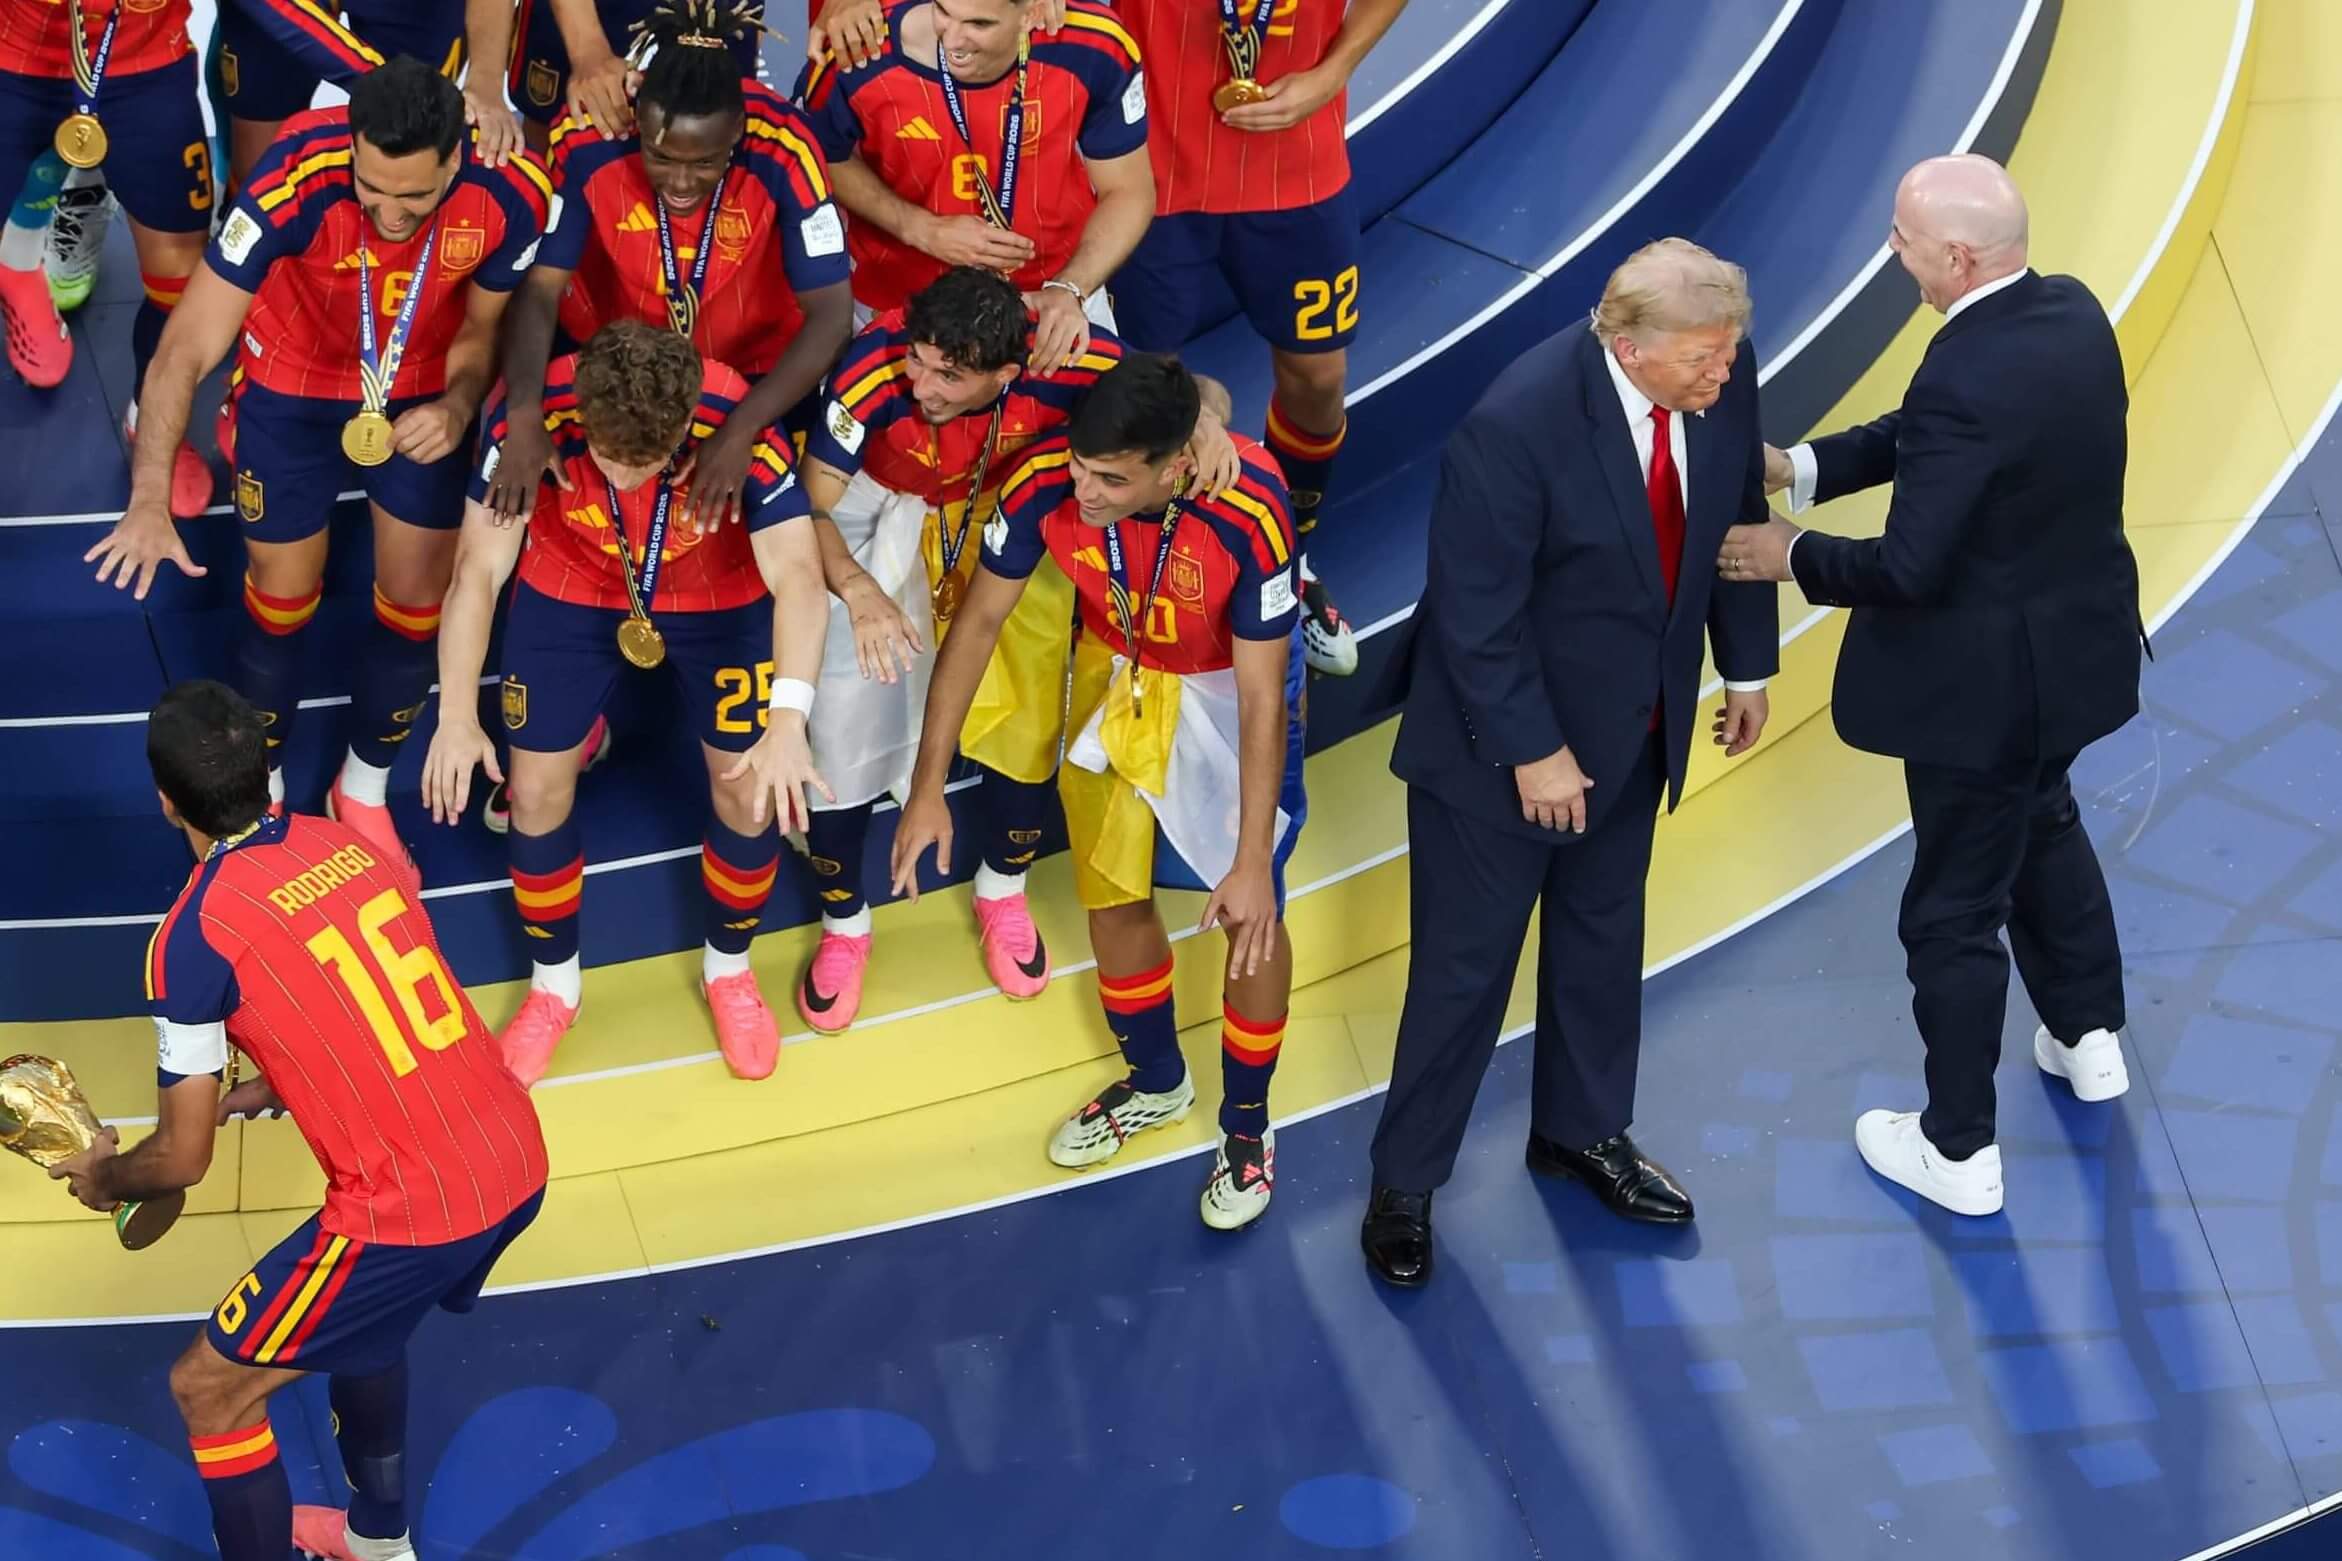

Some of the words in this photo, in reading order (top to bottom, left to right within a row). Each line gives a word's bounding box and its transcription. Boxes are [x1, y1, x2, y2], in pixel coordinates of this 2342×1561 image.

[1006, 144, 1016, 161] CUP
[1008, 114, 1020, 144] 2026
[184, 142, 210, 210] 3
[952, 154, 987, 200] 8
[1000, 190, 1011, 208] FIFA
[1003, 161, 1014, 190] WORLD
[401, 298, 415, 322] FIFA
[409, 262, 425, 298] WORLD
[1295, 265, 1359, 340] 22
[652, 523, 663, 542] CUP
[646, 542, 659, 573] WORLD
[642, 573, 653, 593] FIFA
[1105, 591, 1178, 644] 20
[715, 661, 775, 733] 25
[267, 844, 376, 917] RODRIGO
[305, 887, 468, 1078] 16
[218, 1273, 263, 1335] 6
